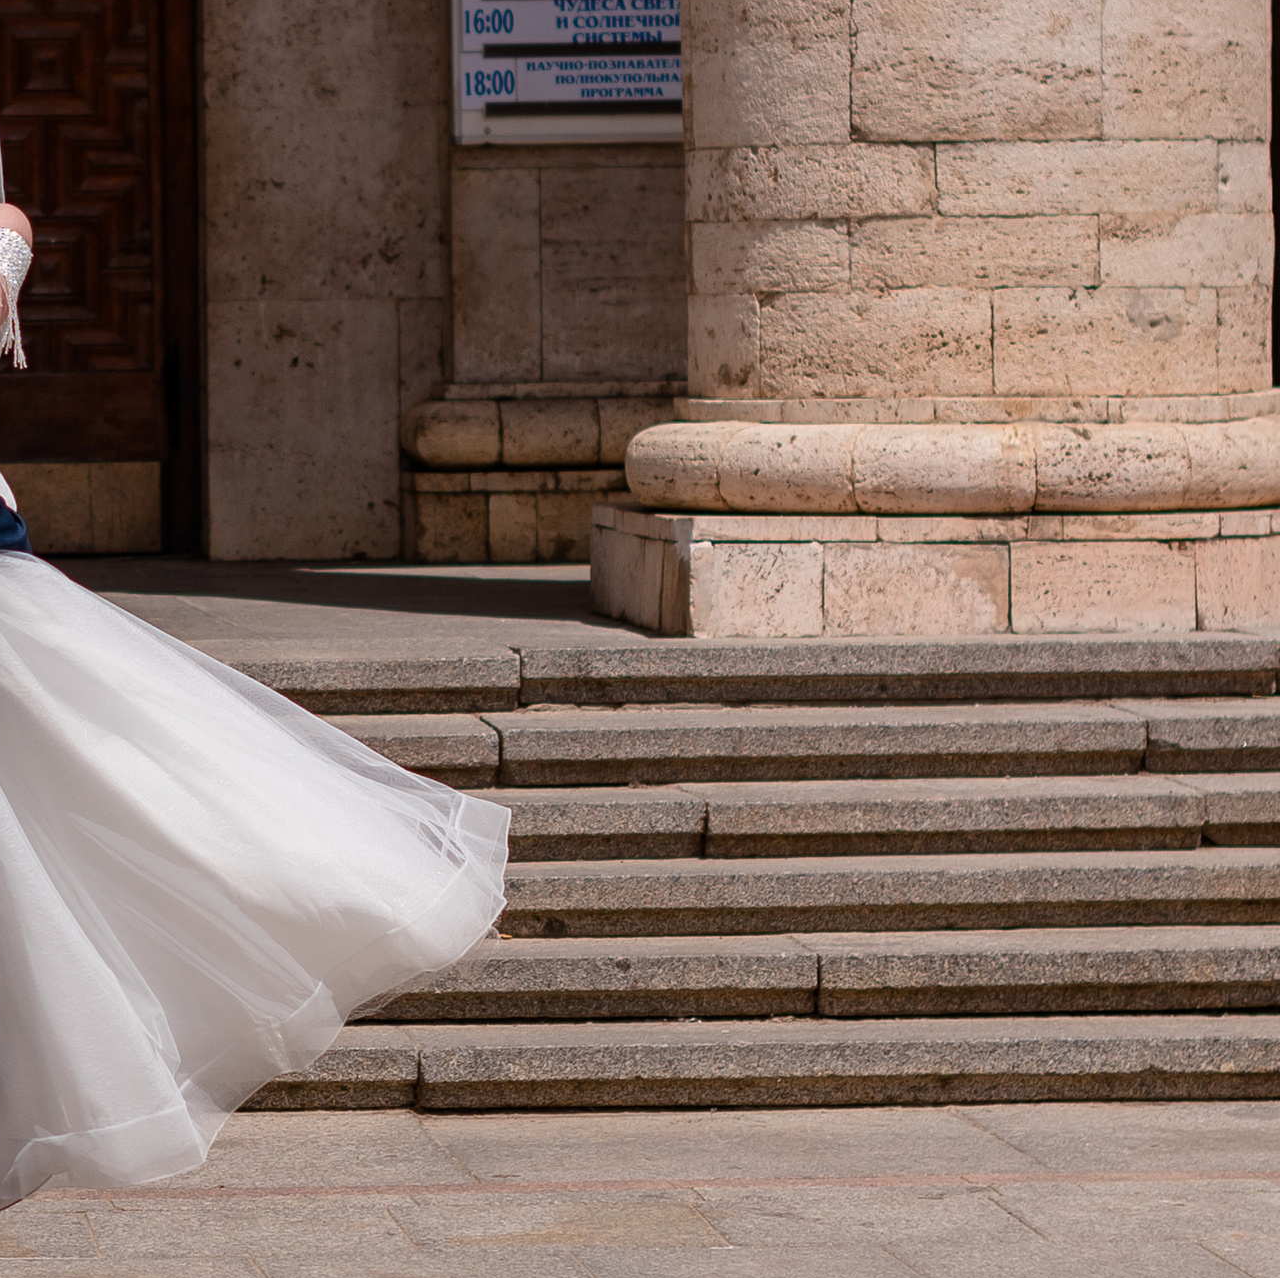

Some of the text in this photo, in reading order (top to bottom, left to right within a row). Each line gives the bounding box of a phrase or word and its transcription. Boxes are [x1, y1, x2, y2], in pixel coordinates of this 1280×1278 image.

[464, 8, 514, 34] 16:00
[556, 16, 569, 29] И
[572, 30, 662, 44] СИСТЕМЫ
[464, 69, 515, 96] 18:00
[555, 73, 682, 85] ПОЛНОКУПОЛЬНА
[581, 86, 664, 98] ПРОГРАММА
